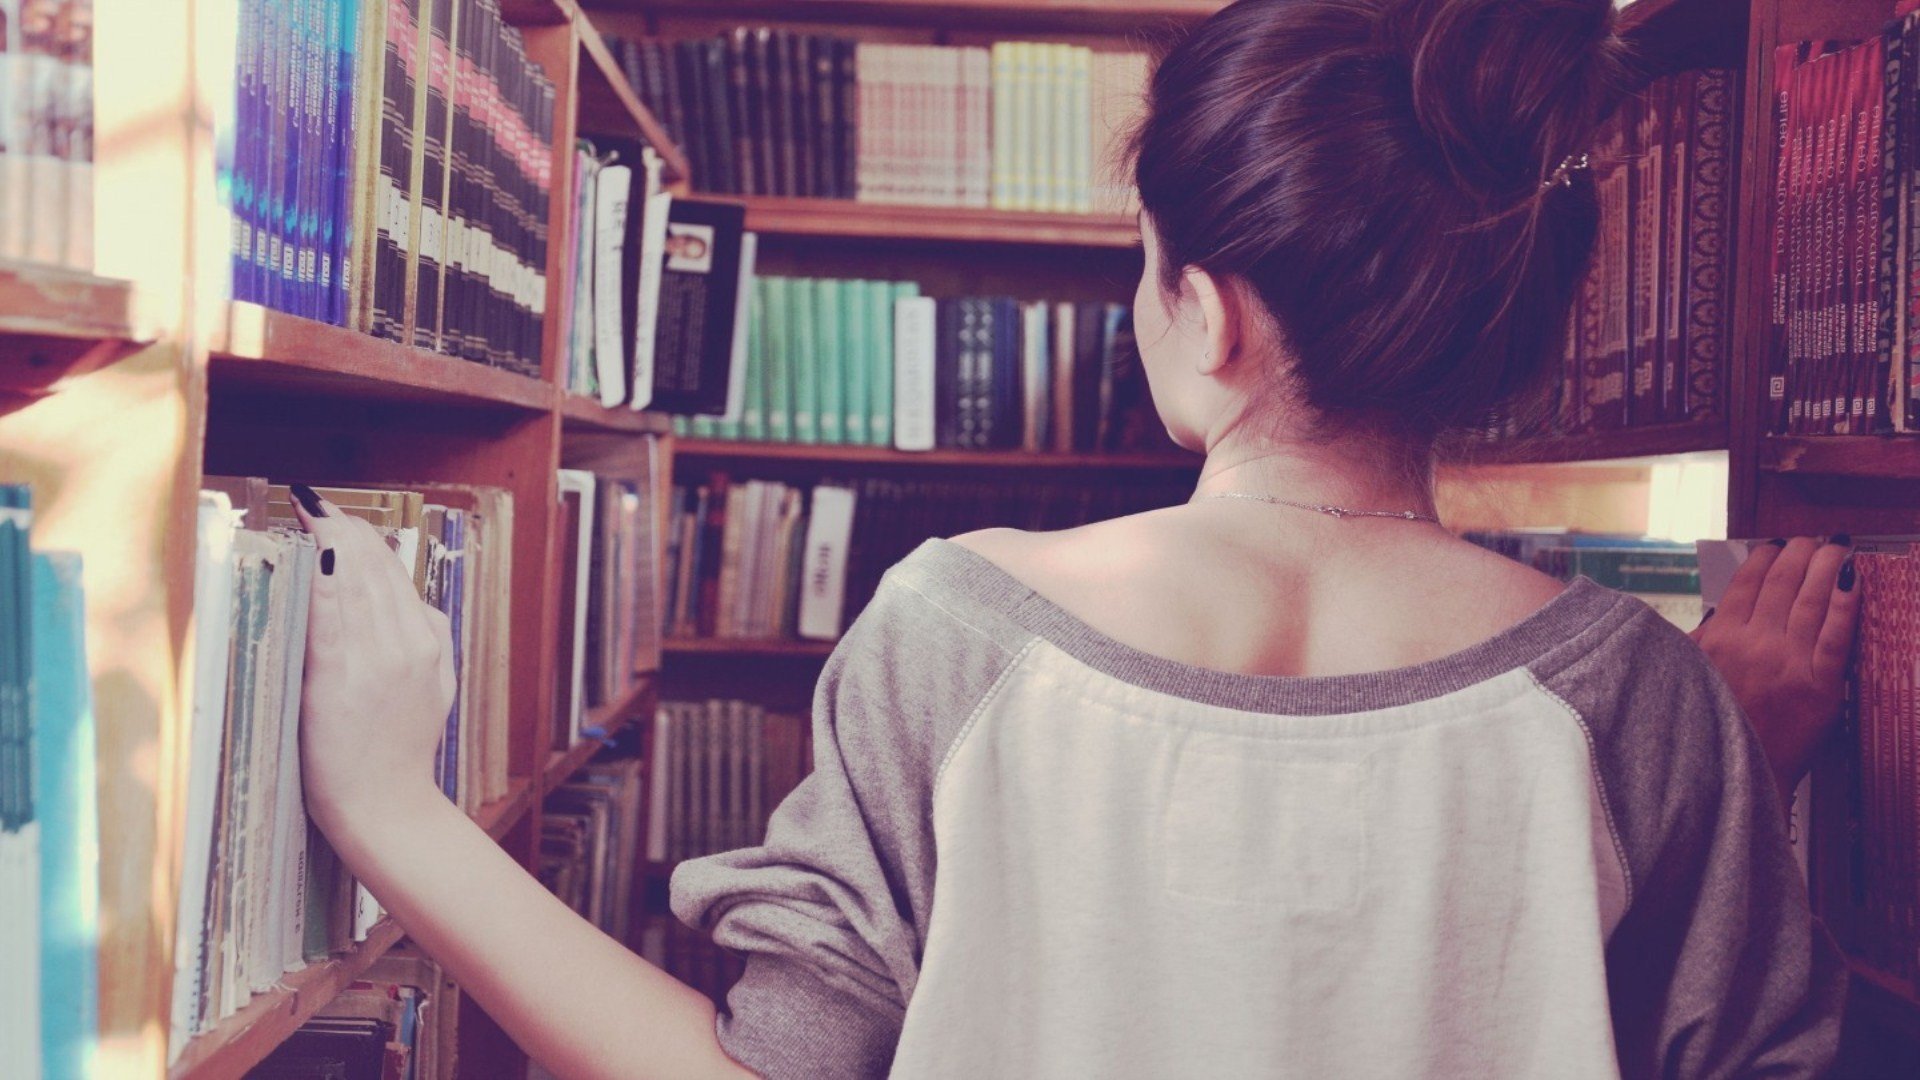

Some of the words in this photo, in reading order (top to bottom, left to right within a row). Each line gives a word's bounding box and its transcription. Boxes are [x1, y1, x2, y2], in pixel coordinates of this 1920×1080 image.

[1779, 90, 1788, 148] QƏLBƏ
[1858, 111, 1867, 172] QƏLBƏ
[1777, 156, 1787, 254] DODAQDAN
[1825, 186, 1834, 289] DODAQDAN
[1837, 181, 1846, 286] DODAQDAN
[1855, 180, 1866, 286] DODAQDAN
[1868, 176, 1879, 282] DODAQDAN
